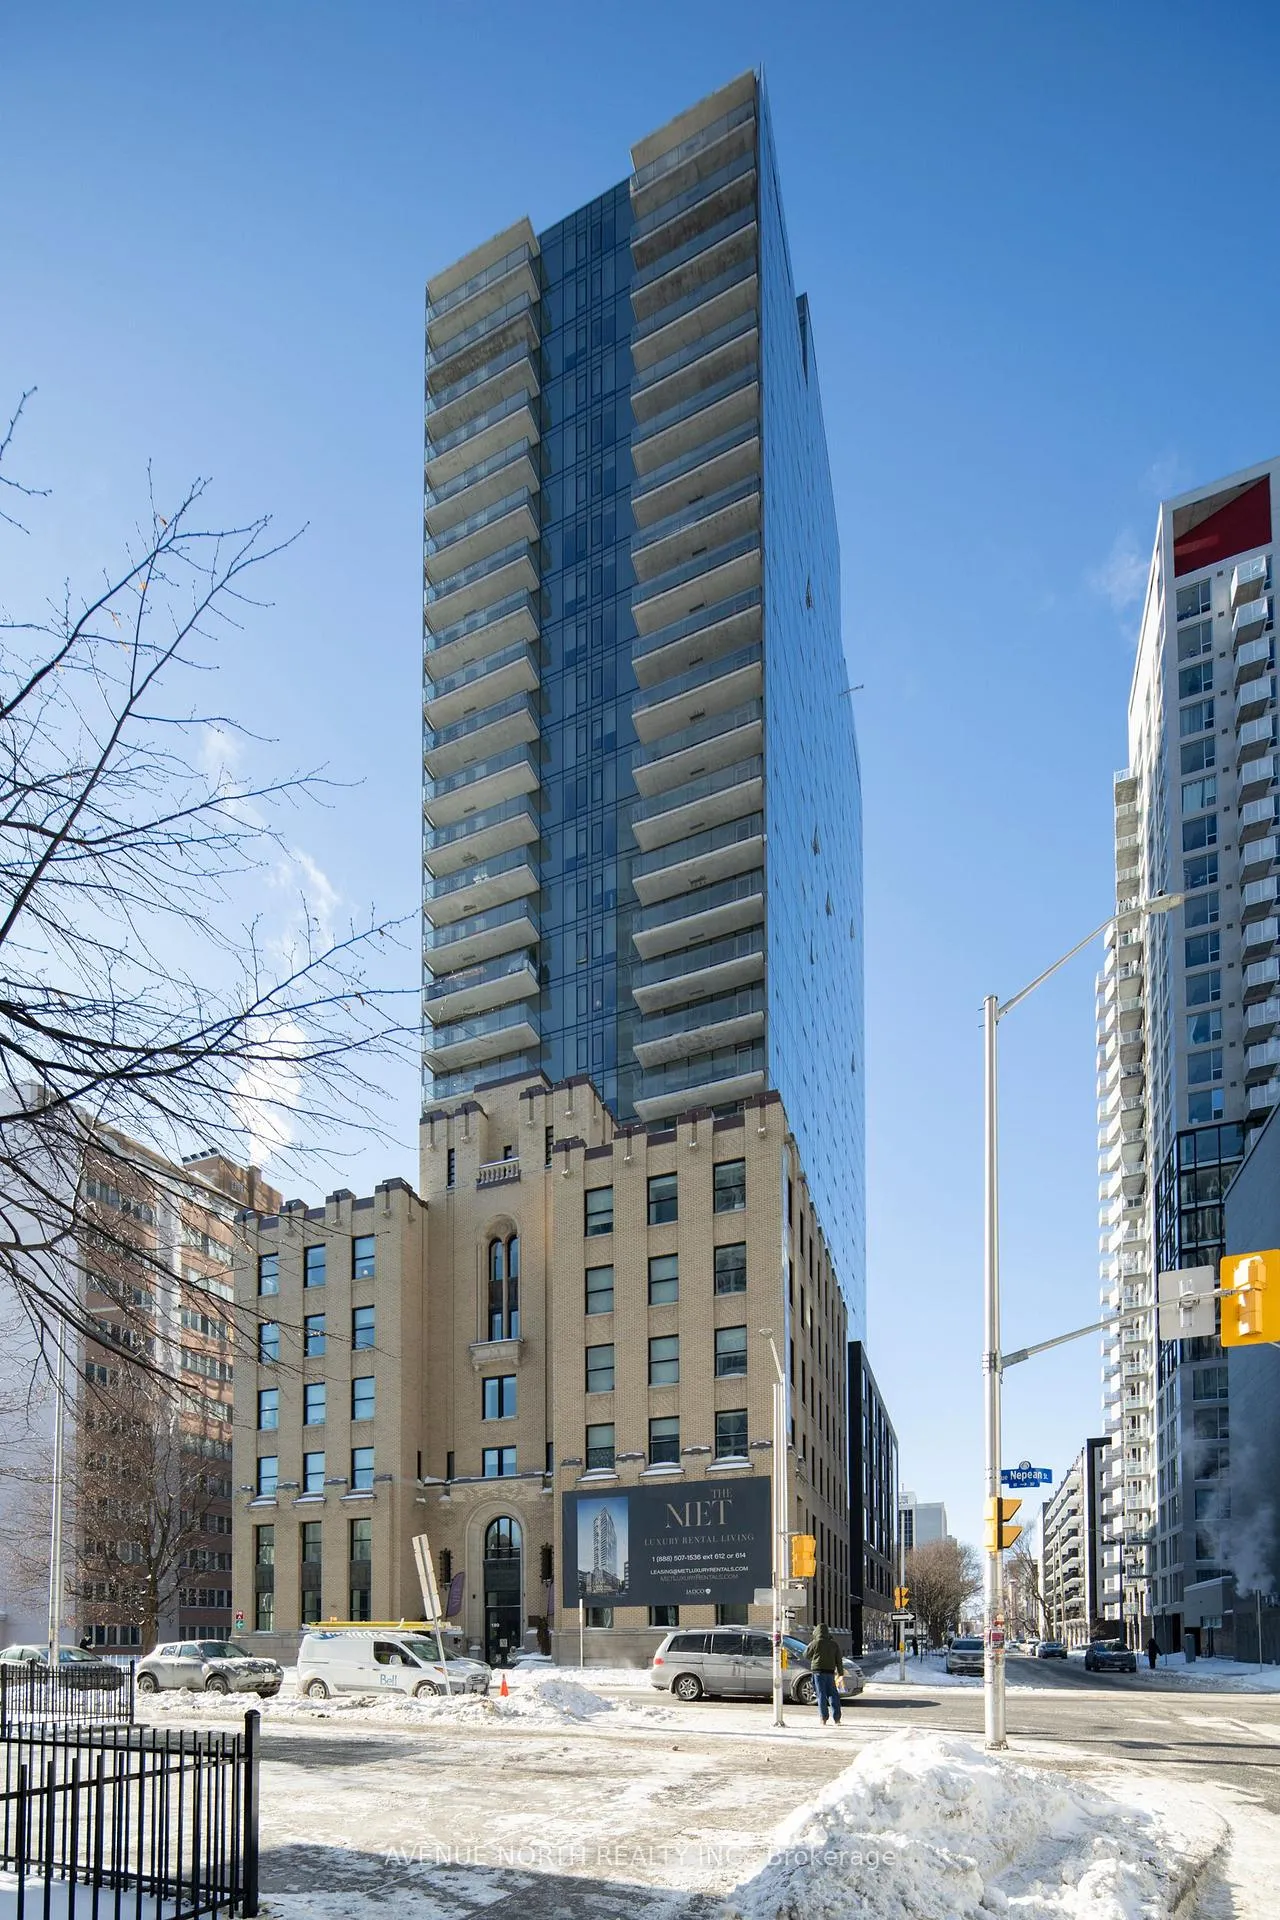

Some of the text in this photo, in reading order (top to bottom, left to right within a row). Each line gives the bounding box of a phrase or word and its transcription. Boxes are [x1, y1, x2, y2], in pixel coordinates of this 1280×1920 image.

[1010, 1470, 1043, 1481] Nepean
[710, 1488, 733, 1499] THE
[665, 1499, 733, 1529] MET
[644, 1533, 754, 1546] LUXURY RENTAL LIVING
[380, 1674, 397, 1686] Bell
